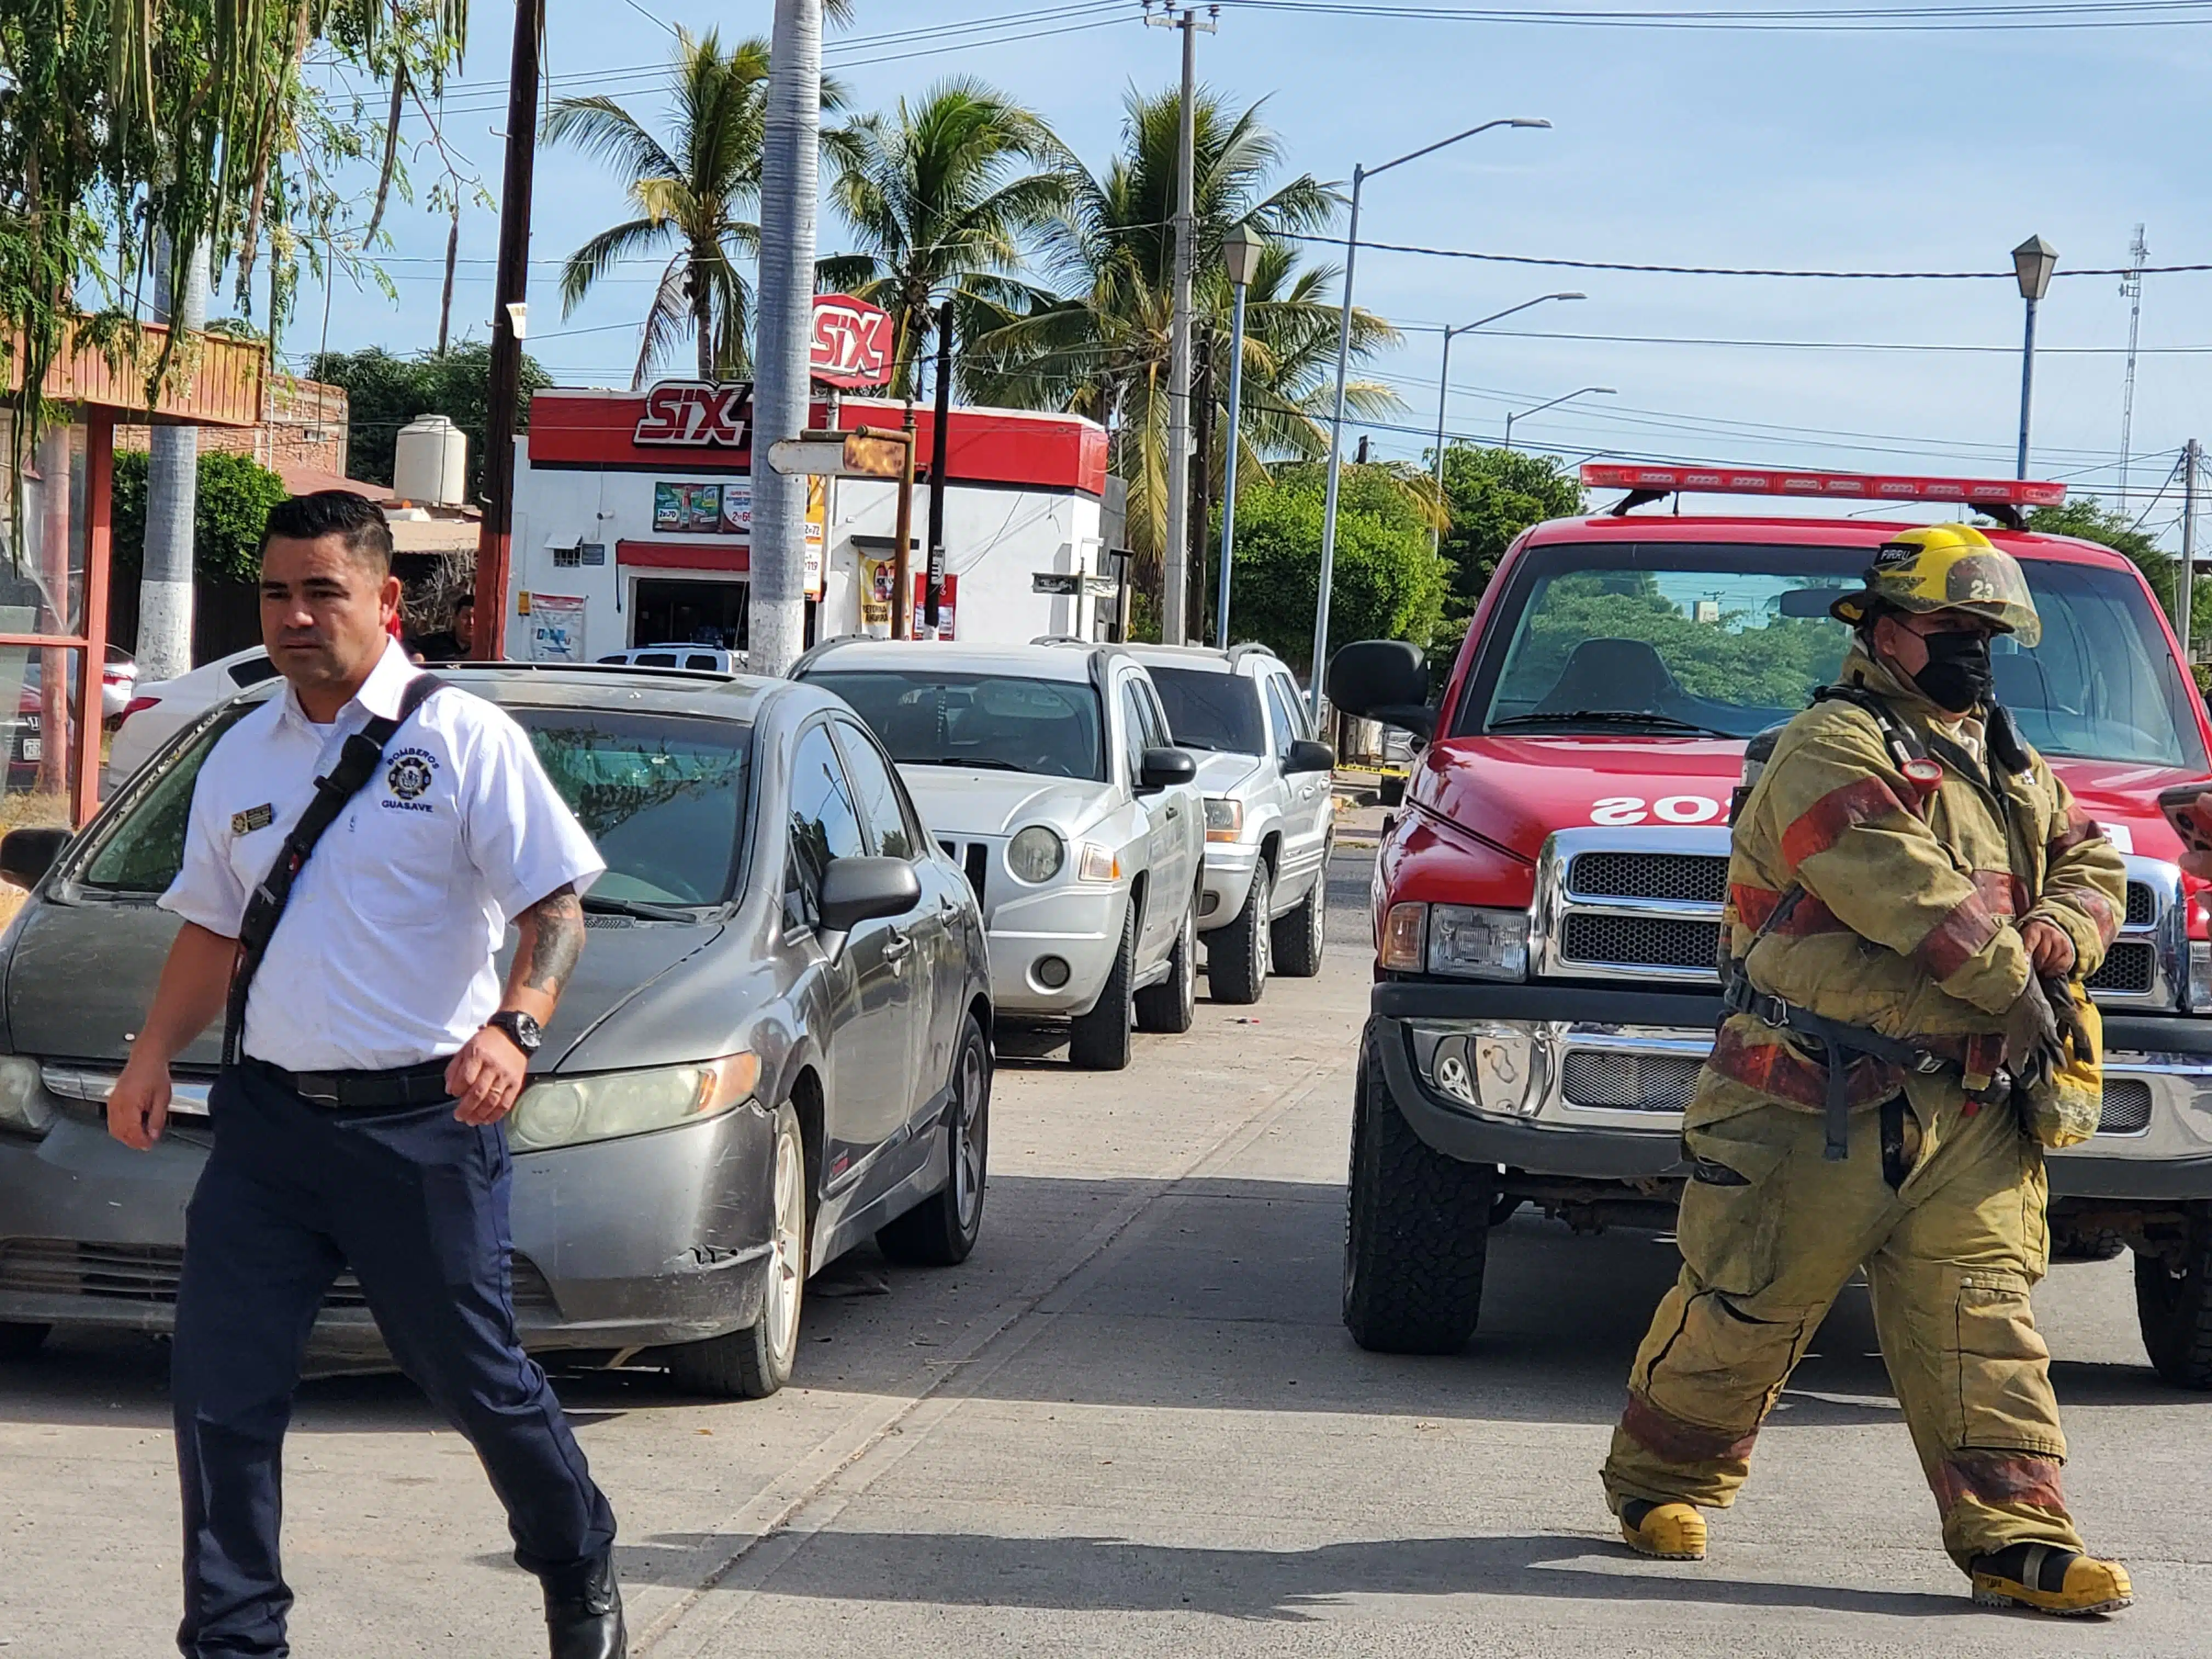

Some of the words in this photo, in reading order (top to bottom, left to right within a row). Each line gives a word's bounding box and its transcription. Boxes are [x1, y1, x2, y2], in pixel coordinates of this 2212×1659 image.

[1970, 579, 1994, 599] 23
[386, 747, 439, 769] BOMBEROS
[382, 800, 433, 812] GUASAVE
